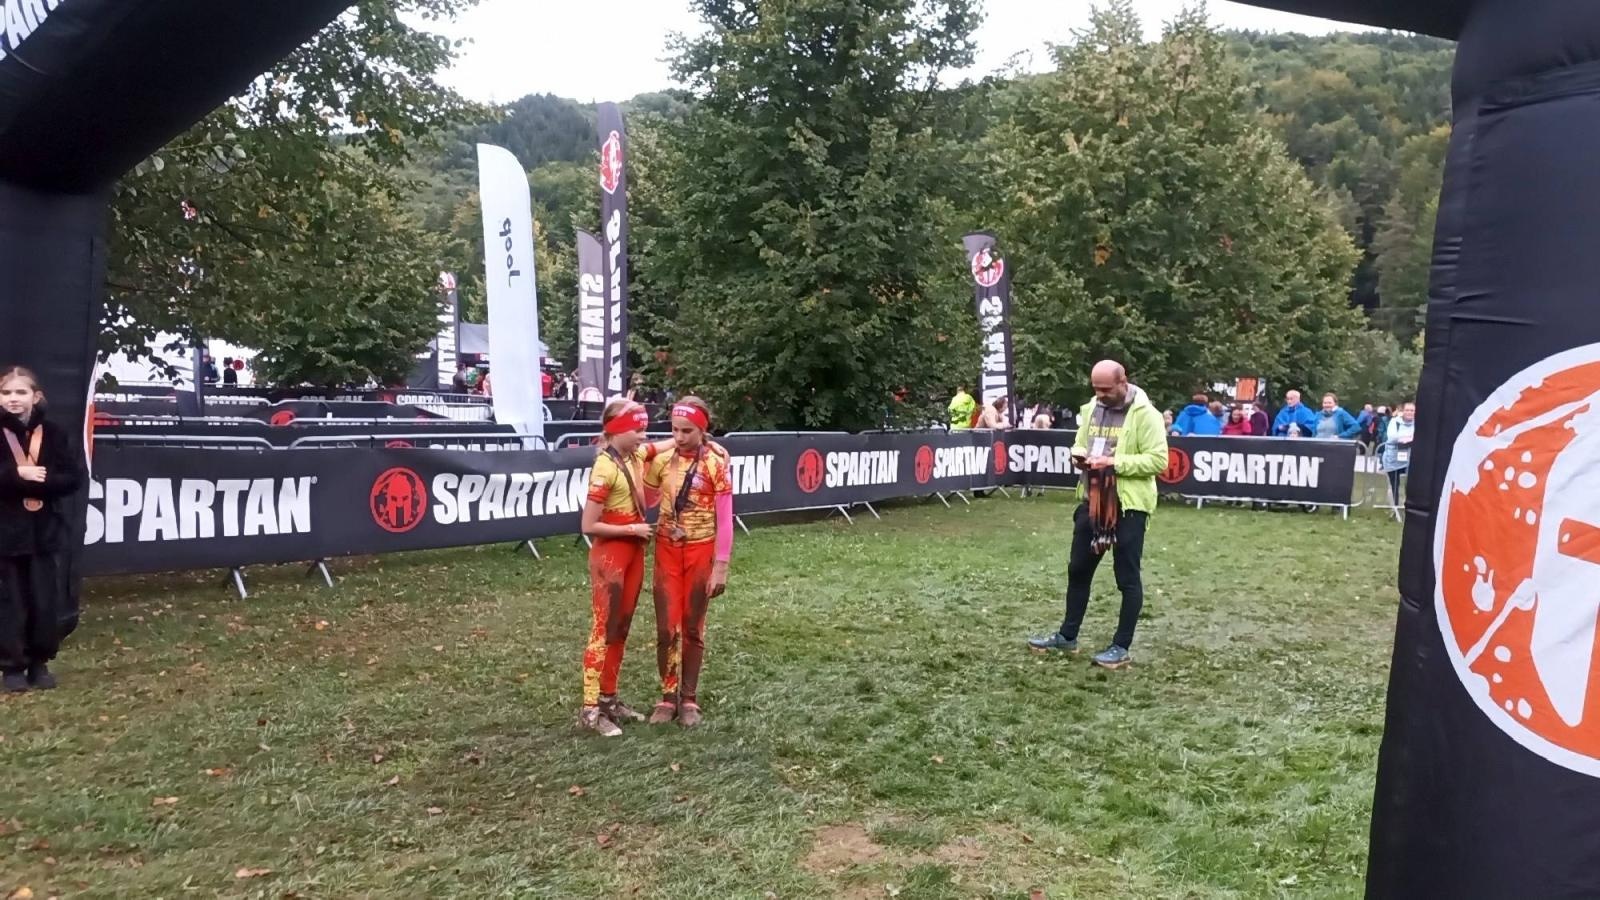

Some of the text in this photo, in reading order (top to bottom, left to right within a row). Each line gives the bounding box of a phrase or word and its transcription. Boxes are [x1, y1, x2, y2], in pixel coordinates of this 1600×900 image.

[826, 450, 899, 488] SPARTAN
[933, 446, 991, 479] SPARTAN
[1008, 444, 1080, 474] SPAR
[1193, 452, 1319, 488] SPARTAN
[432, 467, 593, 524] SPARTAN
